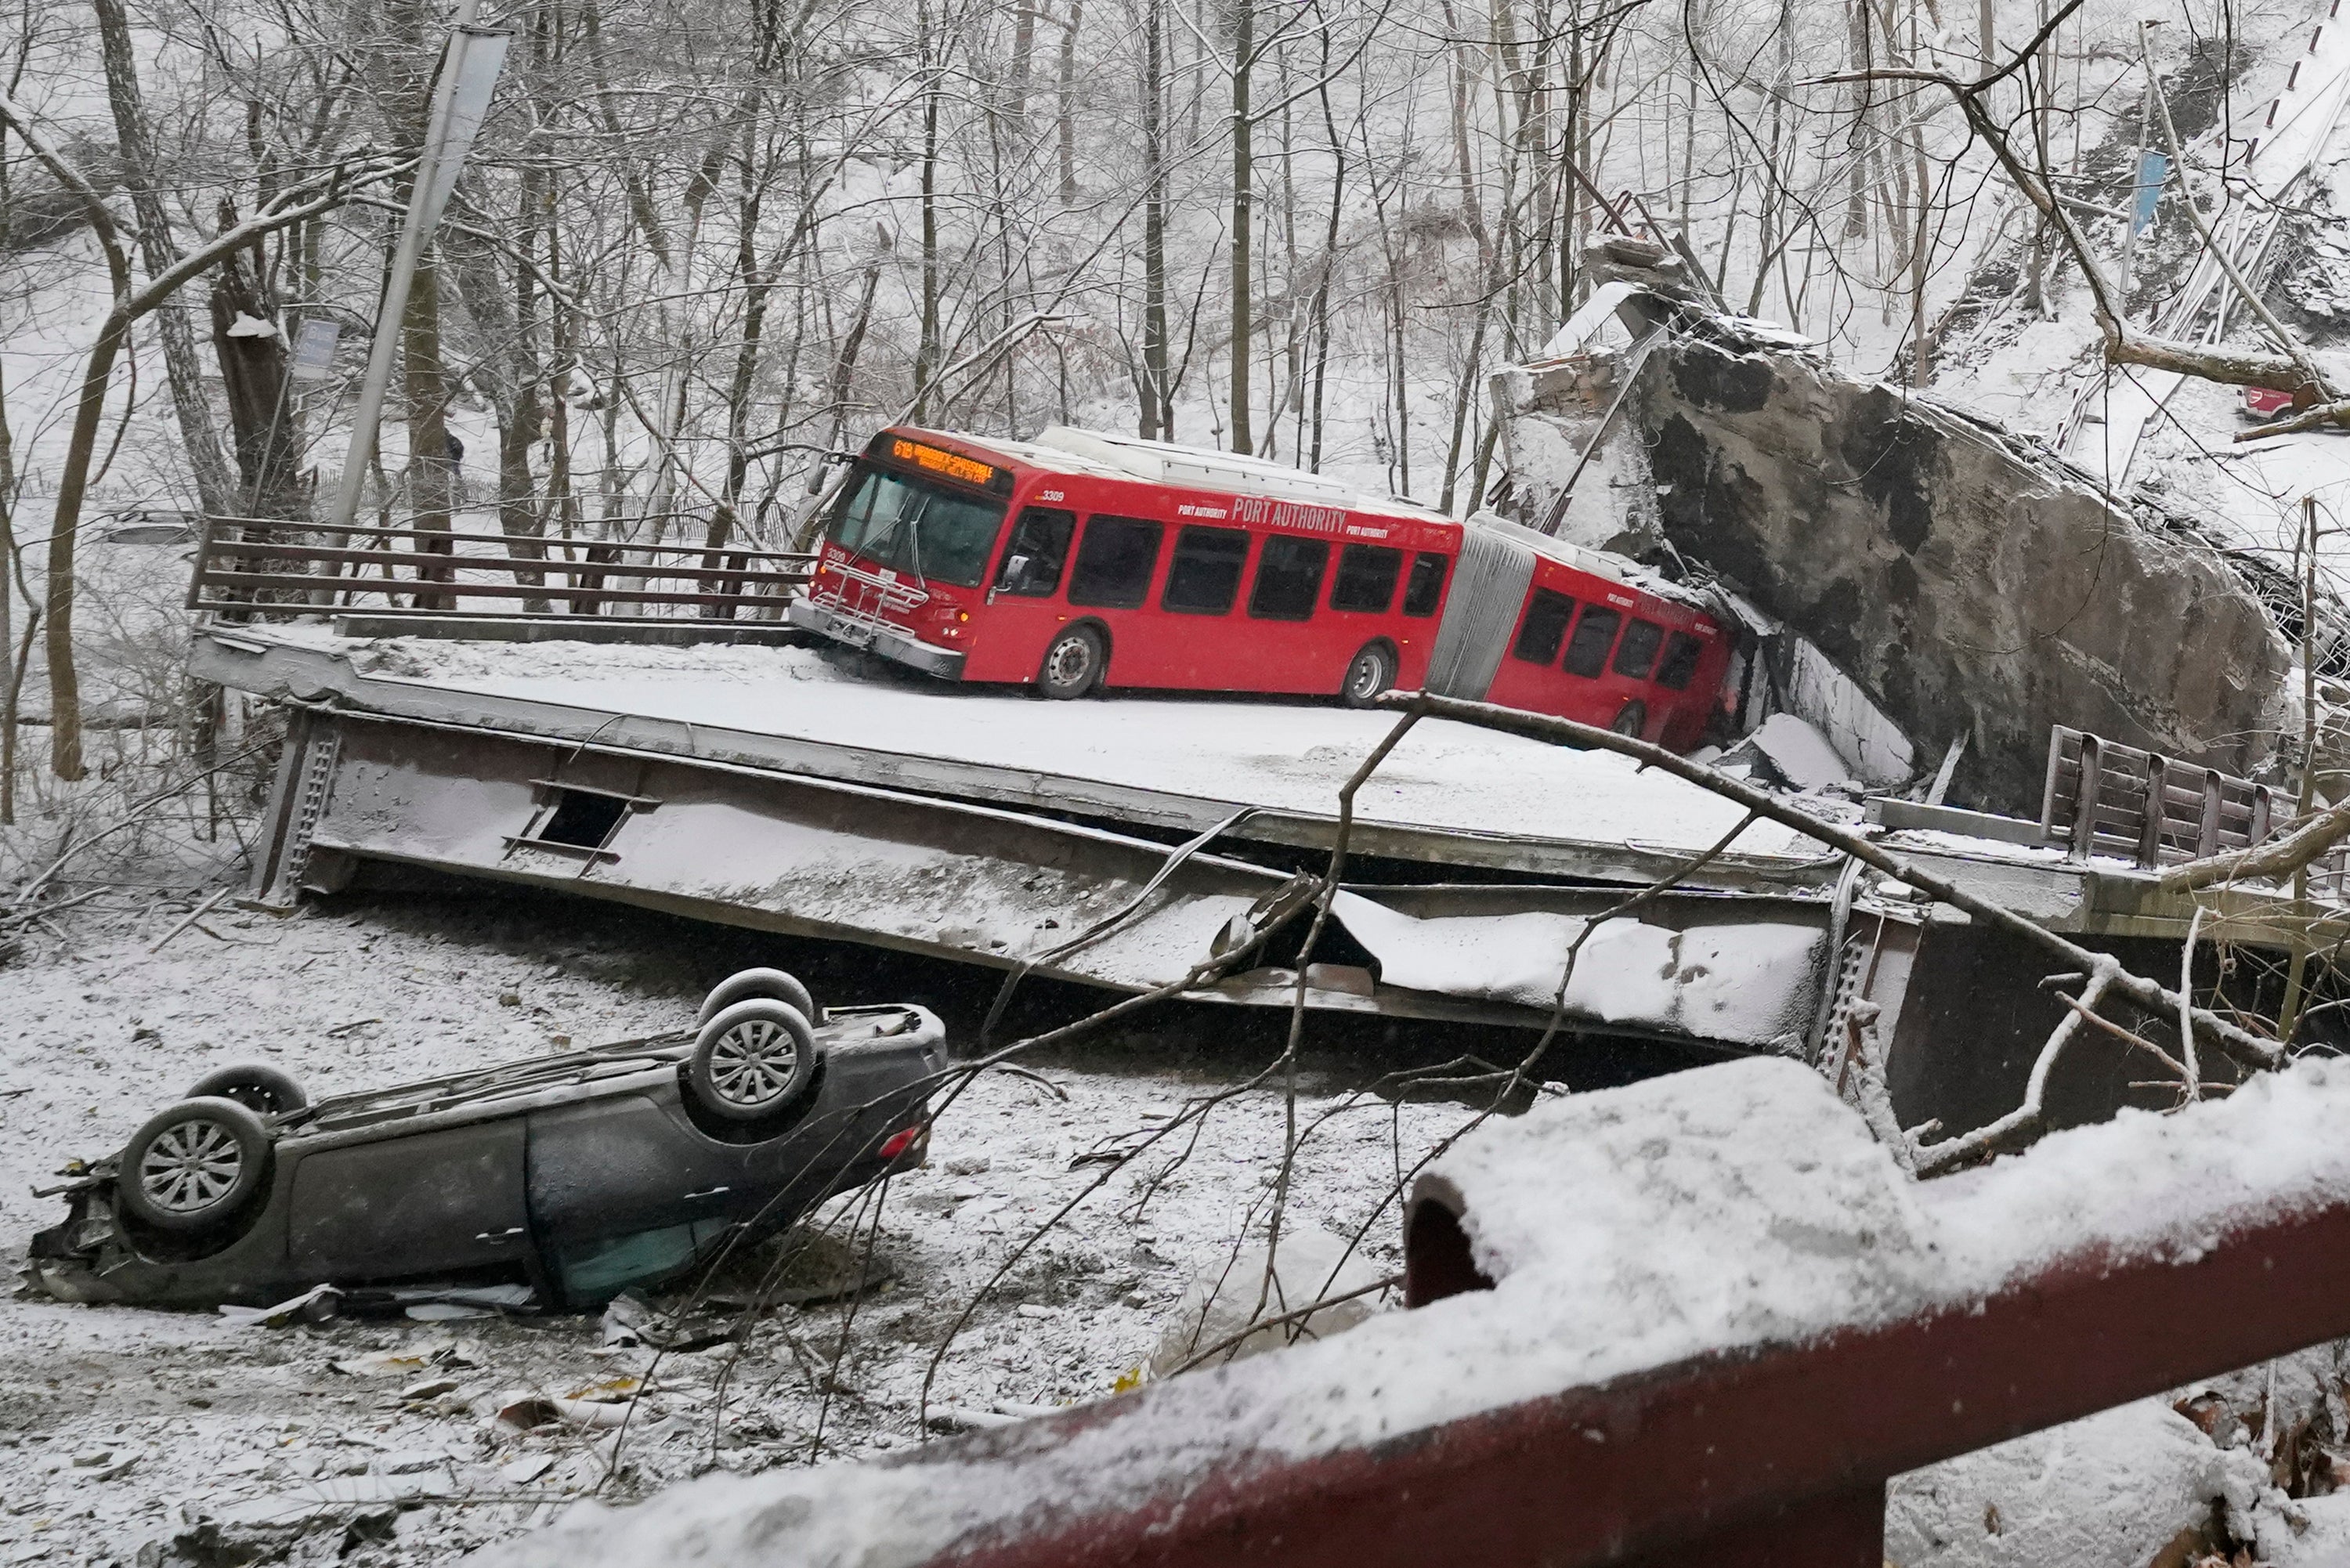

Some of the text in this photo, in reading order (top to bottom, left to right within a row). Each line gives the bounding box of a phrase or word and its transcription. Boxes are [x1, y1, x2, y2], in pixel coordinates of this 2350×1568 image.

[894, 439, 913, 459] 61B
[1043, 490, 1065, 502] 3309
[1178, 505, 1227, 519] PORT AUTHORITY
[1232, 498, 1346, 533] PORT AUTHORITY
[1347, 526, 1361, 536] PORT
[827, 547, 846, 563] 3309
